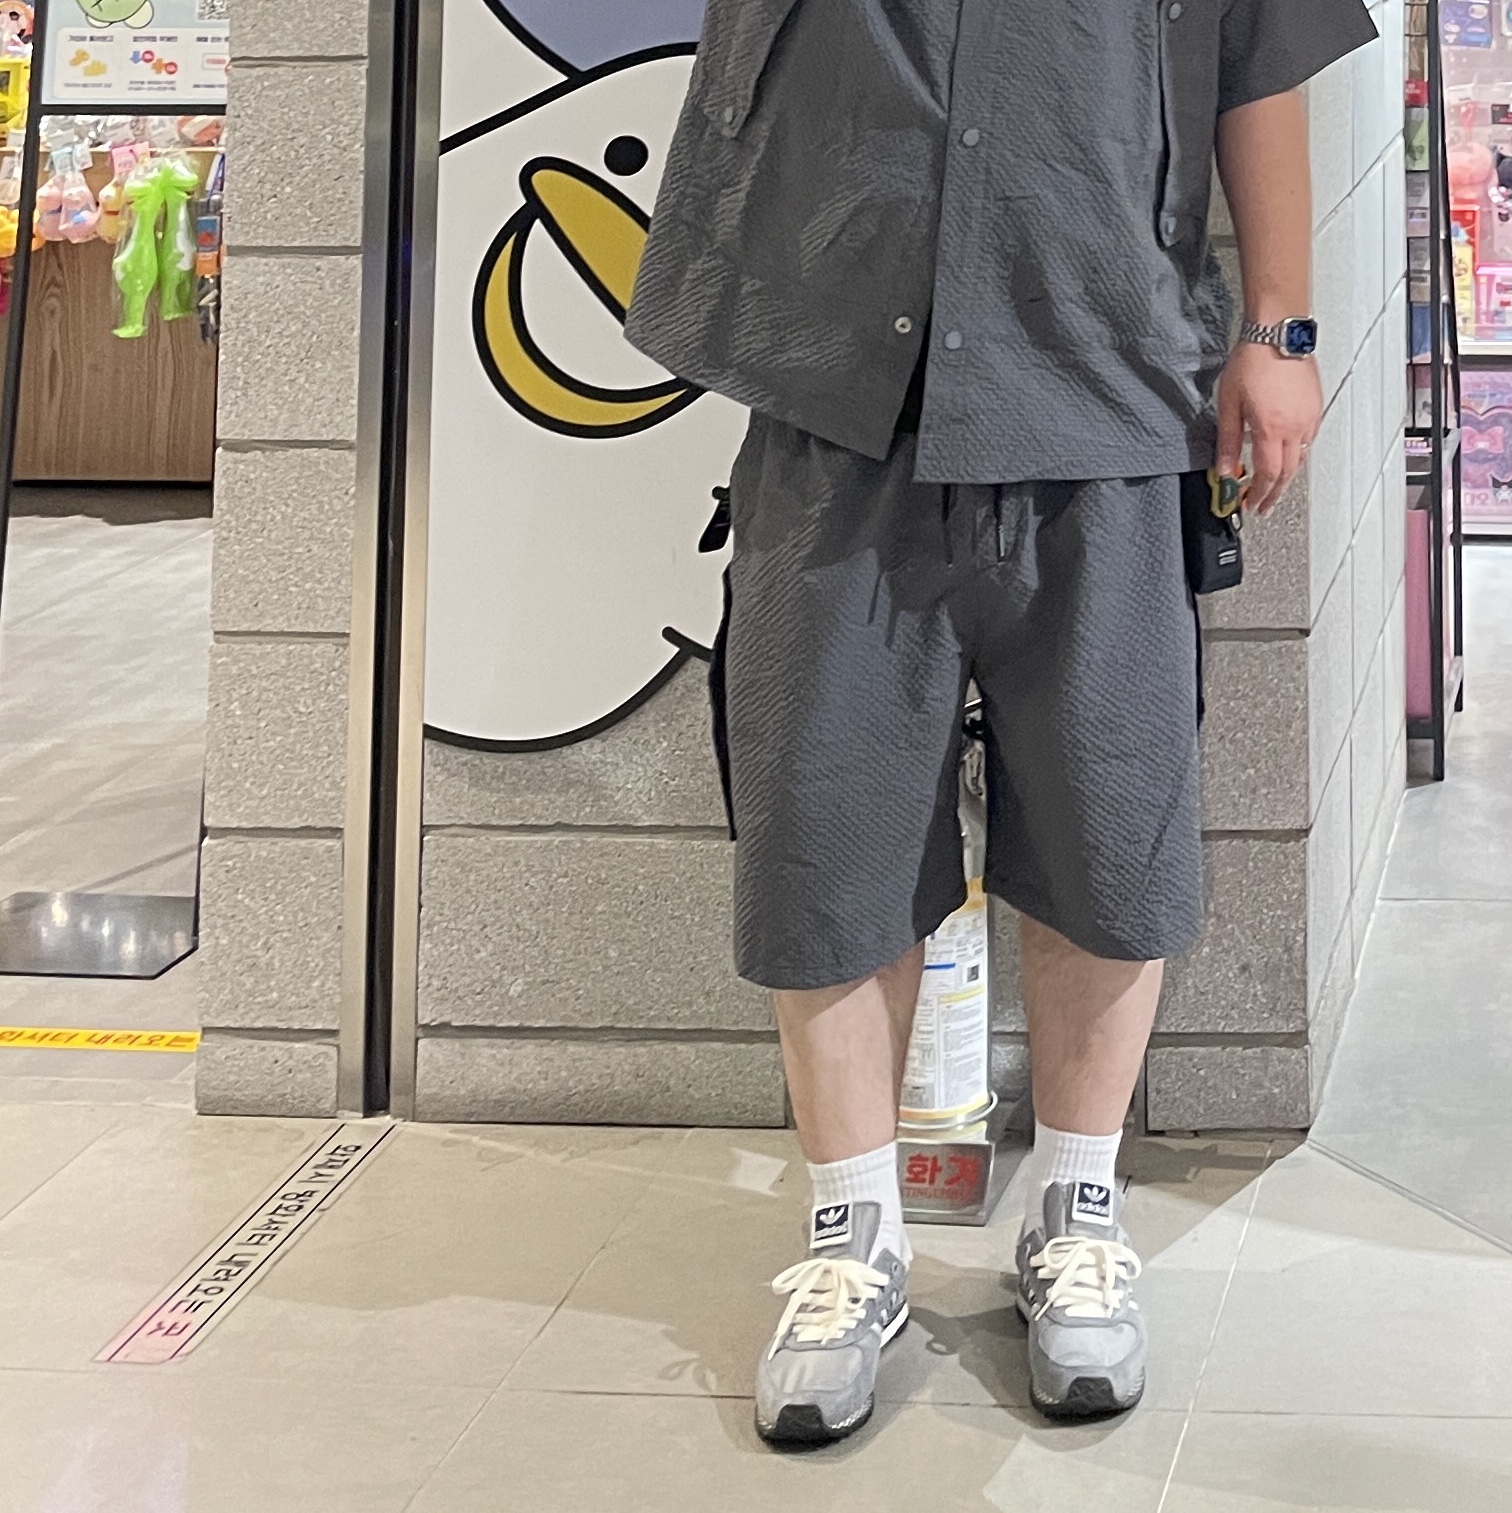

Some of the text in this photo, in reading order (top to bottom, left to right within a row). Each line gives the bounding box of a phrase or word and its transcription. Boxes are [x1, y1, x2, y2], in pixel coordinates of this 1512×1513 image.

[297, 1144, 362, 1184] 화재시
[236, 1190, 320, 1246] 방화셔터
[168, 1252, 259, 1314] 내려오는
